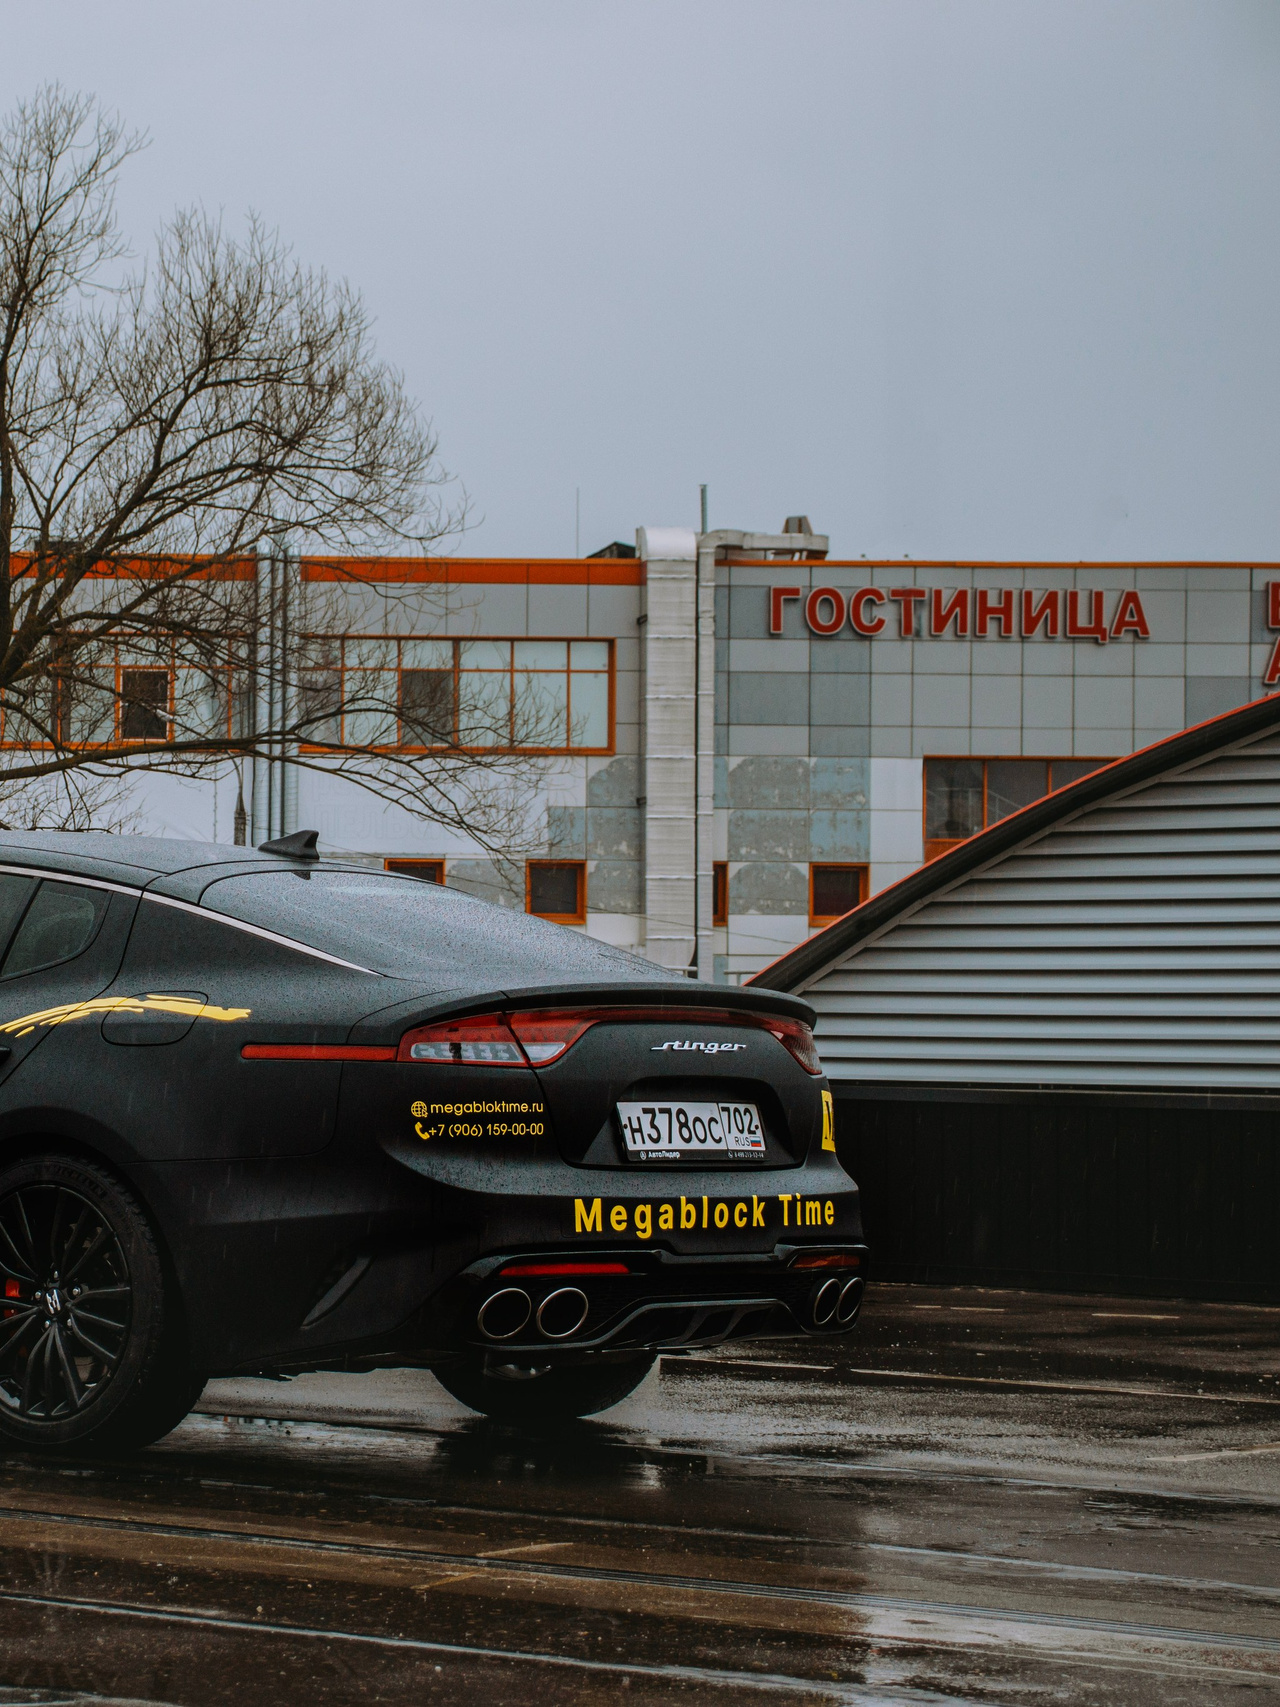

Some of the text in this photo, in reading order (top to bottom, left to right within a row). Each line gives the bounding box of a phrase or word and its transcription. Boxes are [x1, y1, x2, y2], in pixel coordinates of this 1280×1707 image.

[769, 585, 1151, 644] ГОСТИНИЦА
[651, 1040, 747, 1054] stinger
[430, 1100, 544, 1116] megabloktime.ru
[721, 1106, 757, 1135] 702
[428, 1122, 545, 1138] +7 (906) 159-00-00
[734, 1136, 751, 1147] RUS
[574, 1192, 835, 1239] Megablock Time
